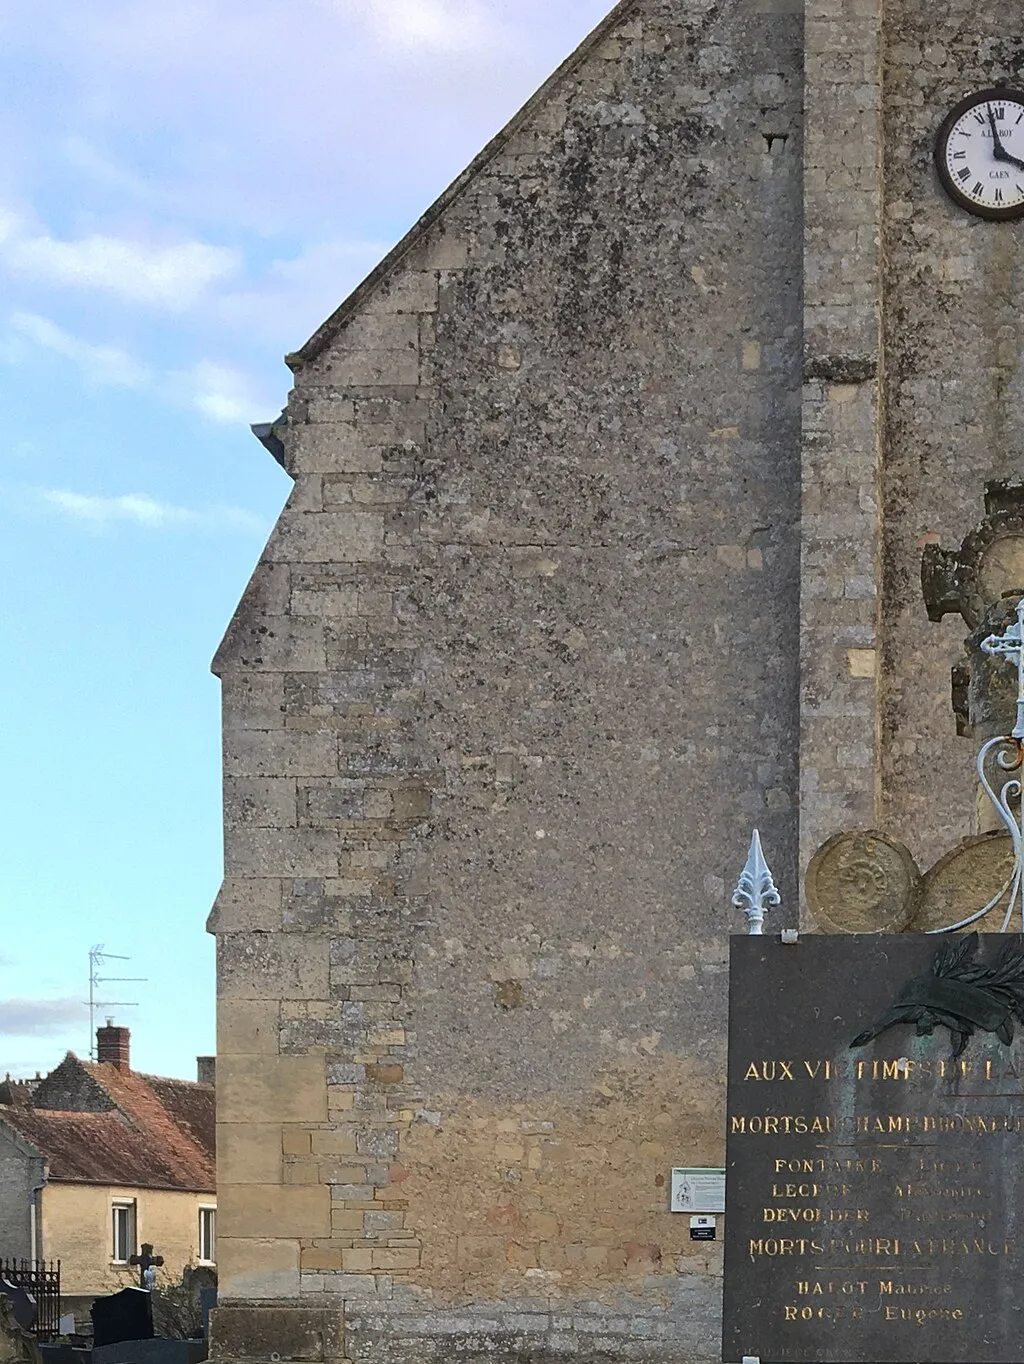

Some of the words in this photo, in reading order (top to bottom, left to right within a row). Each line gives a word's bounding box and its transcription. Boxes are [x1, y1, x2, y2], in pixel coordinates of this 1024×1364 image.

[989, 170, 1010, 179] CAEN
[744, 1060, 795, 1081] AUX
[731, 1115, 809, 1134] MORTS
[748, 1238, 826, 1257] MORTS
